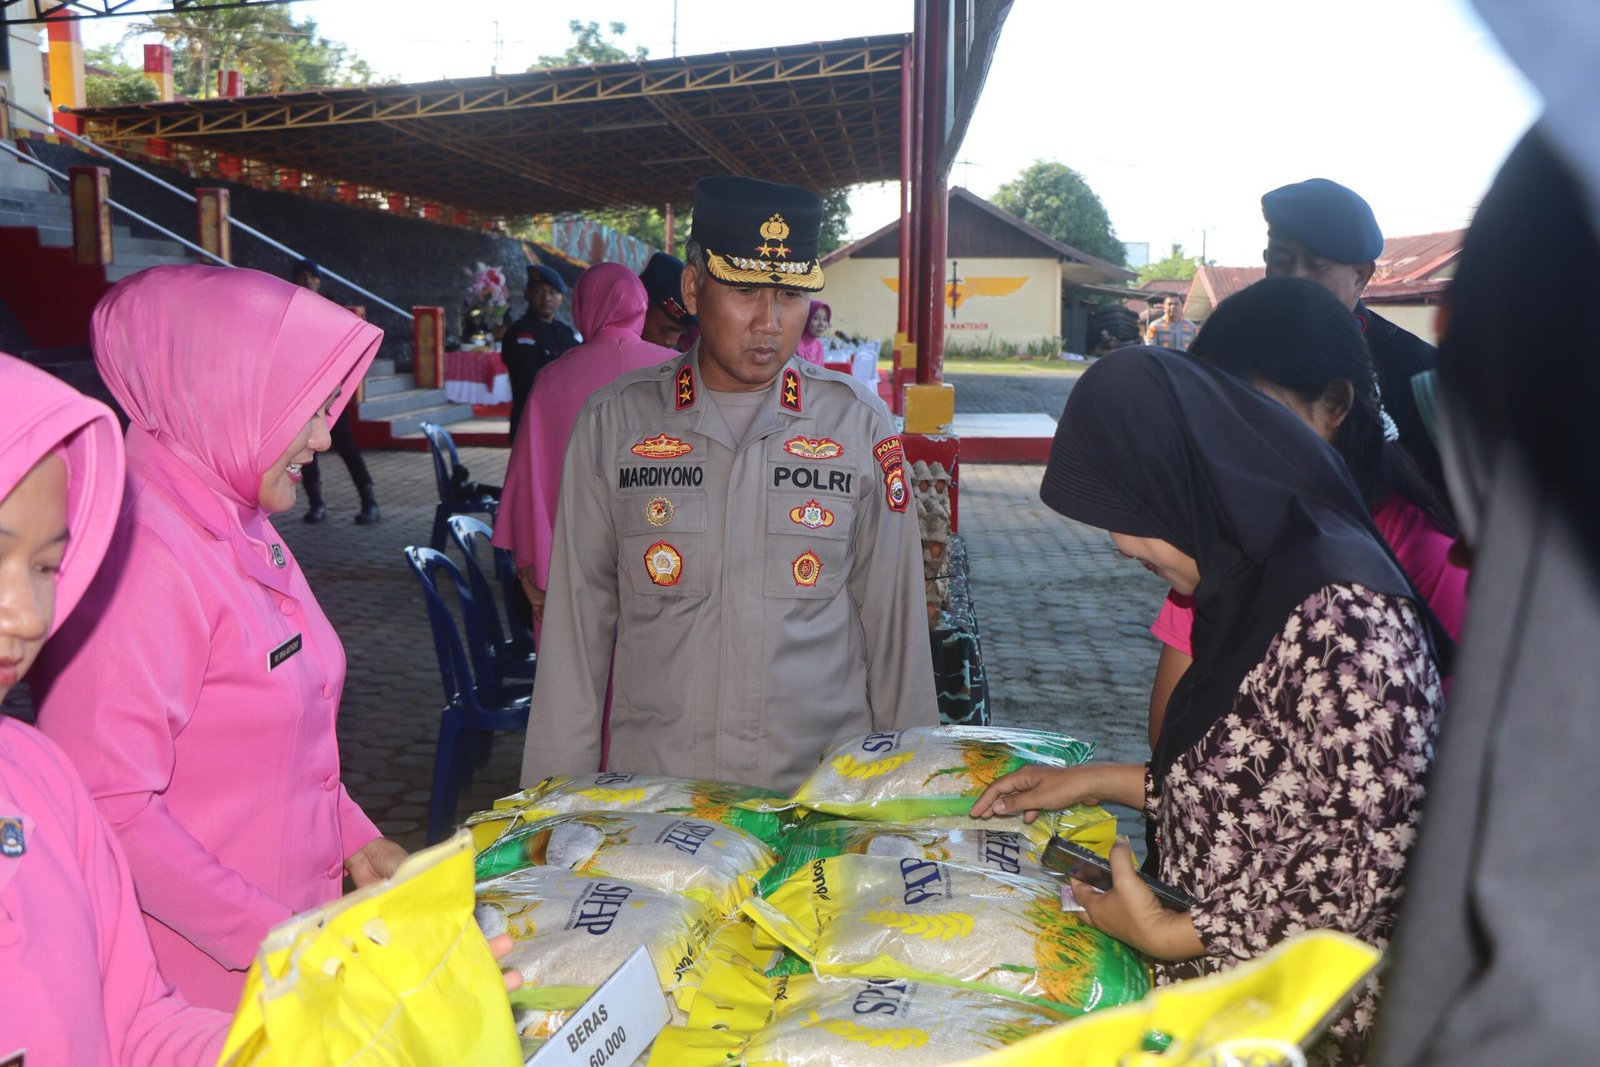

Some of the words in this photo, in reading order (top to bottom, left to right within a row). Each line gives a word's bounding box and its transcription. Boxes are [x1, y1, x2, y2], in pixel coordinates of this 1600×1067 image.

[619, 466, 704, 489] MARDIYONO
[773, 466, 852, 494] POLRI
[566, 1003, 609, 1053] BERAS
[589, 1026, 627, 1067] 60.000
